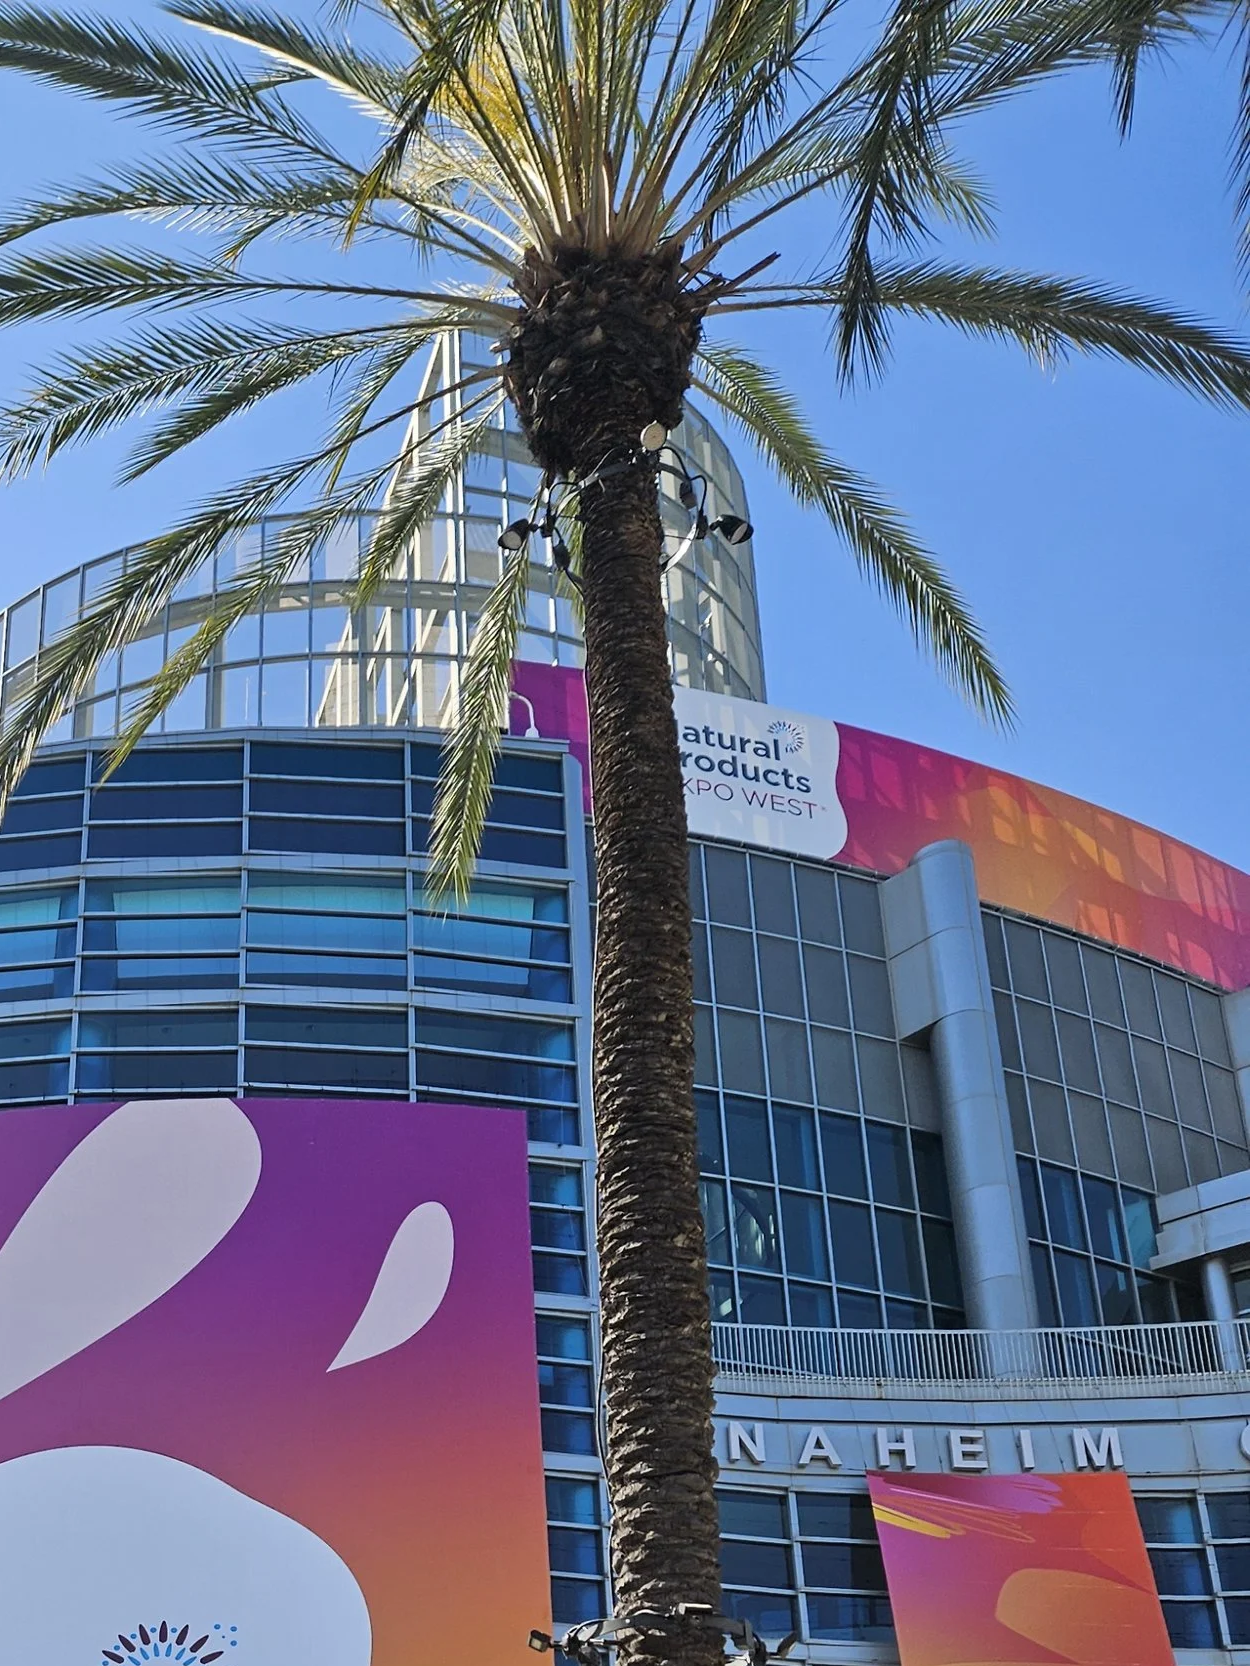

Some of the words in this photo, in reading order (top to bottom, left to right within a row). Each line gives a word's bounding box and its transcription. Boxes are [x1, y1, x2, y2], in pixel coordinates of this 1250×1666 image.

[675, 720, 781, 761] atural
[680, 750, 812, 794] roducts
[682, 776, 734, 802] XPO
[727, 1420, 1124, 1472] NAHEIM
